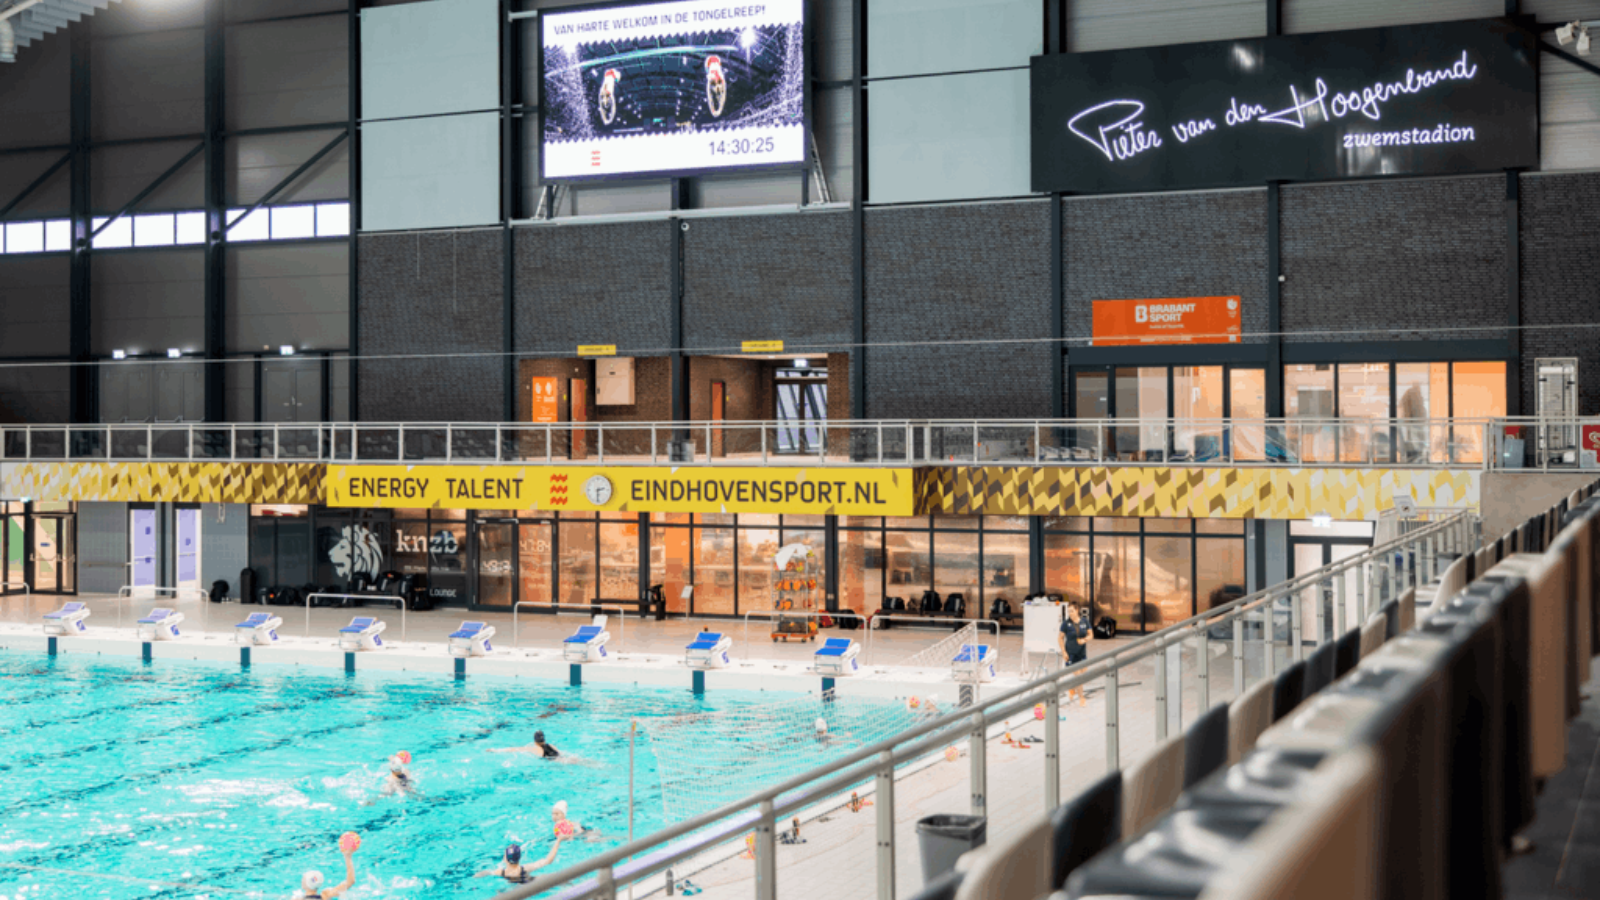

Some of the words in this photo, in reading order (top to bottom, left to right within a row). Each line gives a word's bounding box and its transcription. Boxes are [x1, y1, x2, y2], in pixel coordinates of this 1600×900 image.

[554, 24, 574, 35] VAN
[577, 19, 610, 33] HARTE
[613, 15, 658, 30] WELKOM
[660, 14, 672, 24] IN
[675, 12, 688, 24] DE
[693, 5, 766, 22] TONGELREEP!
[1067, 98, 1163, 162] Pieter
[1172, 118, 1216, 143] van
[1225, 97, 1266, 126] den
[1257, 49, 1478, 129] Hoogenband
[709, 136, 775, 155] 14:30:25
[1343, 123, 1475, 148] zwemstadion
[1149, 303, 1196, 313] BRABANT
[1149, 313, 1182, 323] SPORT
[349, 477, 429, 498] ENERGY
[446, 478, 523, 499] TALENT
[631, 479, 887, 504] EINDHOVENSPORT.NL
[396, 529, 458, 553] knzb
